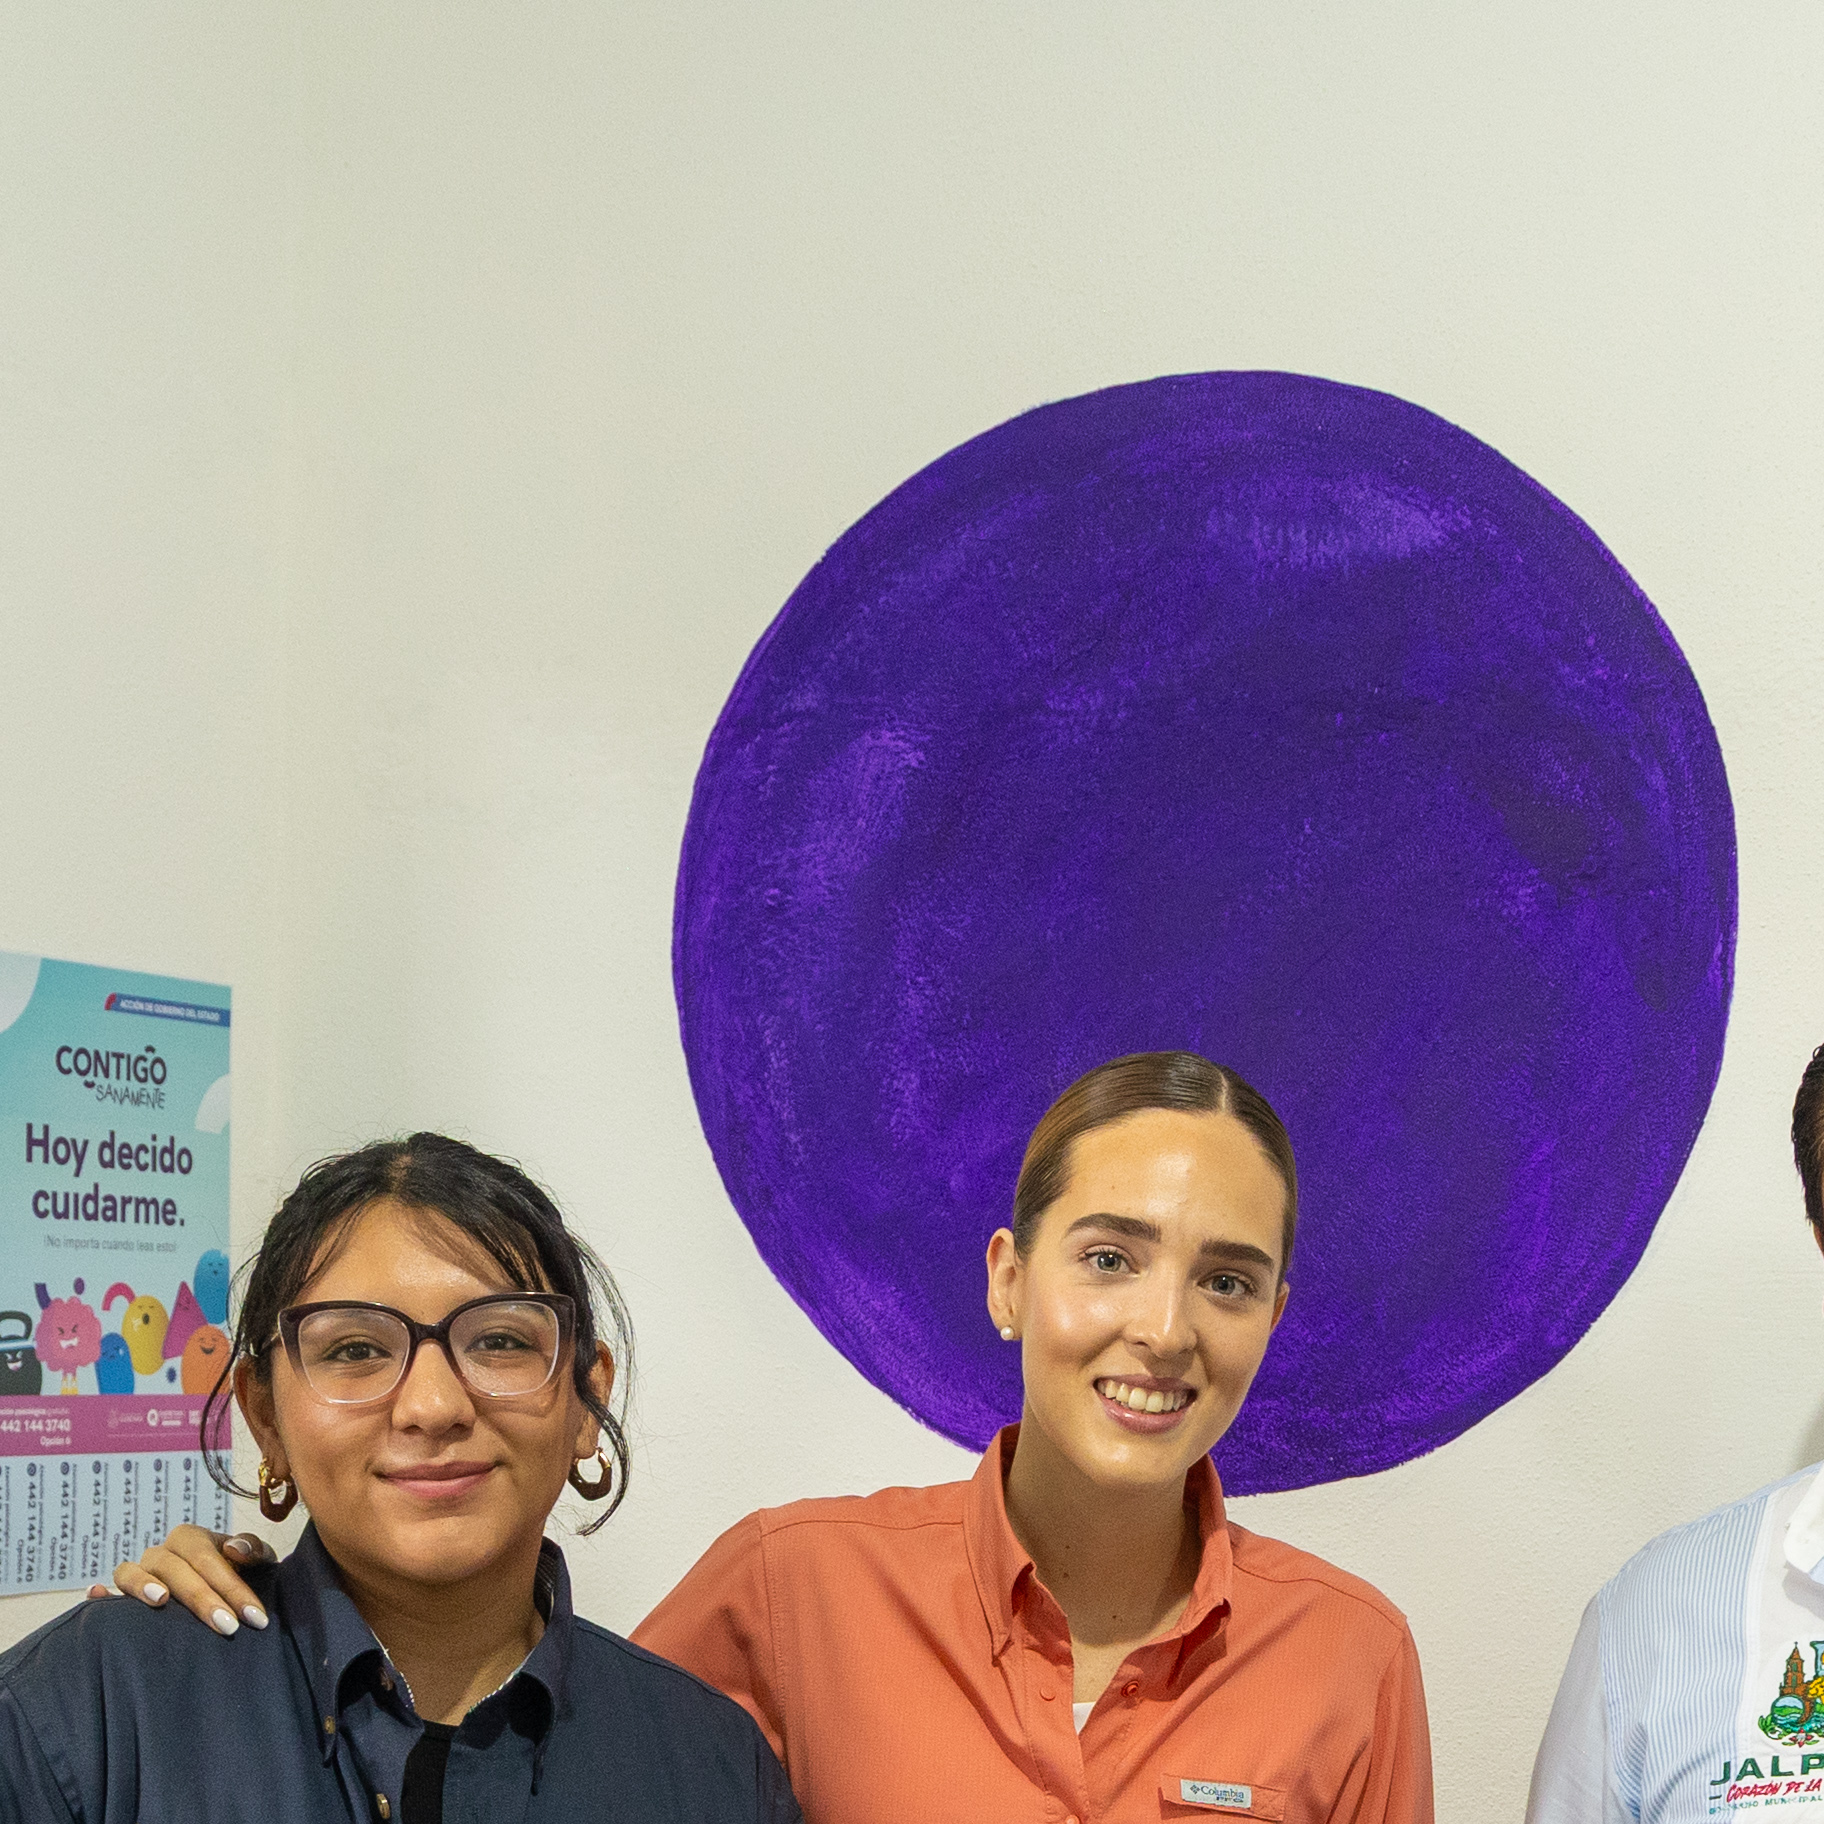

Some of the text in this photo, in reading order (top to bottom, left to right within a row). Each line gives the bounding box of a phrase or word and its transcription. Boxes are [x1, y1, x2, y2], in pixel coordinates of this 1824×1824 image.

[56, 1045, 167, 1085] CONTIGO
[95, 1084, 166, 1109] SANAMENTE
[26, 1122, 193, 1177] Hoy decido
[32, 1182, 185, 1226] cuidarme.
[0, 1418, 71, 1432] 442 144 3740
[123, 1477, 131, 1504] 442
[153, 1475, 161, 1503] 442
[183, 1475, 191, 1501] 442
[25, 1481, 36, 1582] 442 144 3740
[58, 1480, 69, 1580] 442 144 3740
[90, 1479, 101, 1578] 442 144 3740
[123, 1510, 131, 1534] 144
[153, 1509, 161, 1533] 144
[1200, 1785, 1244, 1799] Columbia
